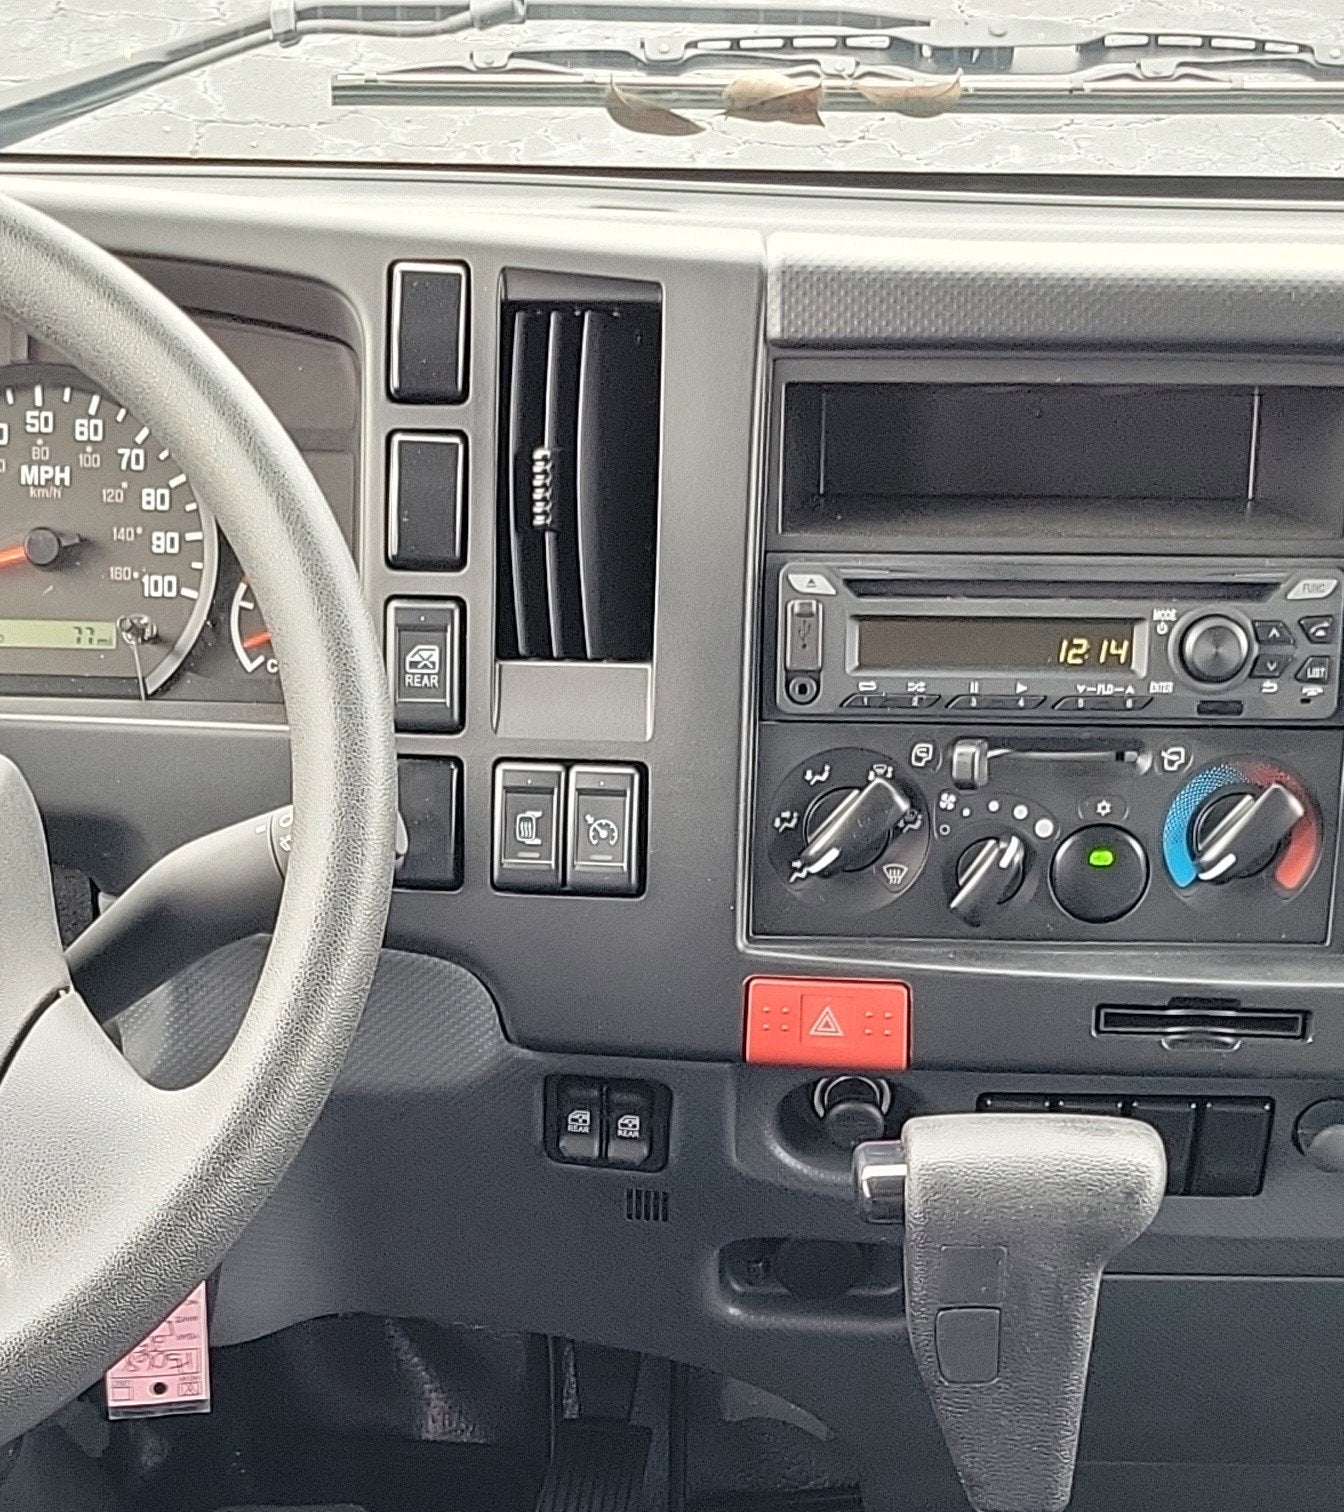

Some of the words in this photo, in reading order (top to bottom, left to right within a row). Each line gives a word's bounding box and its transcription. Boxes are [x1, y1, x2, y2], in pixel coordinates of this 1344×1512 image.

[26, 411, 53, 433] 50
[75, 419, 103, 442] 60
[79, 453, 100, 468] 100
[118, 448, 144, 471] 70
[20, 464, 71, 487] MPH
[29, 486, 63, 499] km/h
[102, 488, 124, 503] 120
[141, 488, 170, 511] 80
[113, 527, 135, 542] 140
[152, 531, 179, 554] 90
[110, 566, 132, 581] 160
[142, 574, 177, 598] 100
[72, 626, 95, 645] 77
[266, 659, 278, 673] C
[405, 674, 438, 688] REAR
